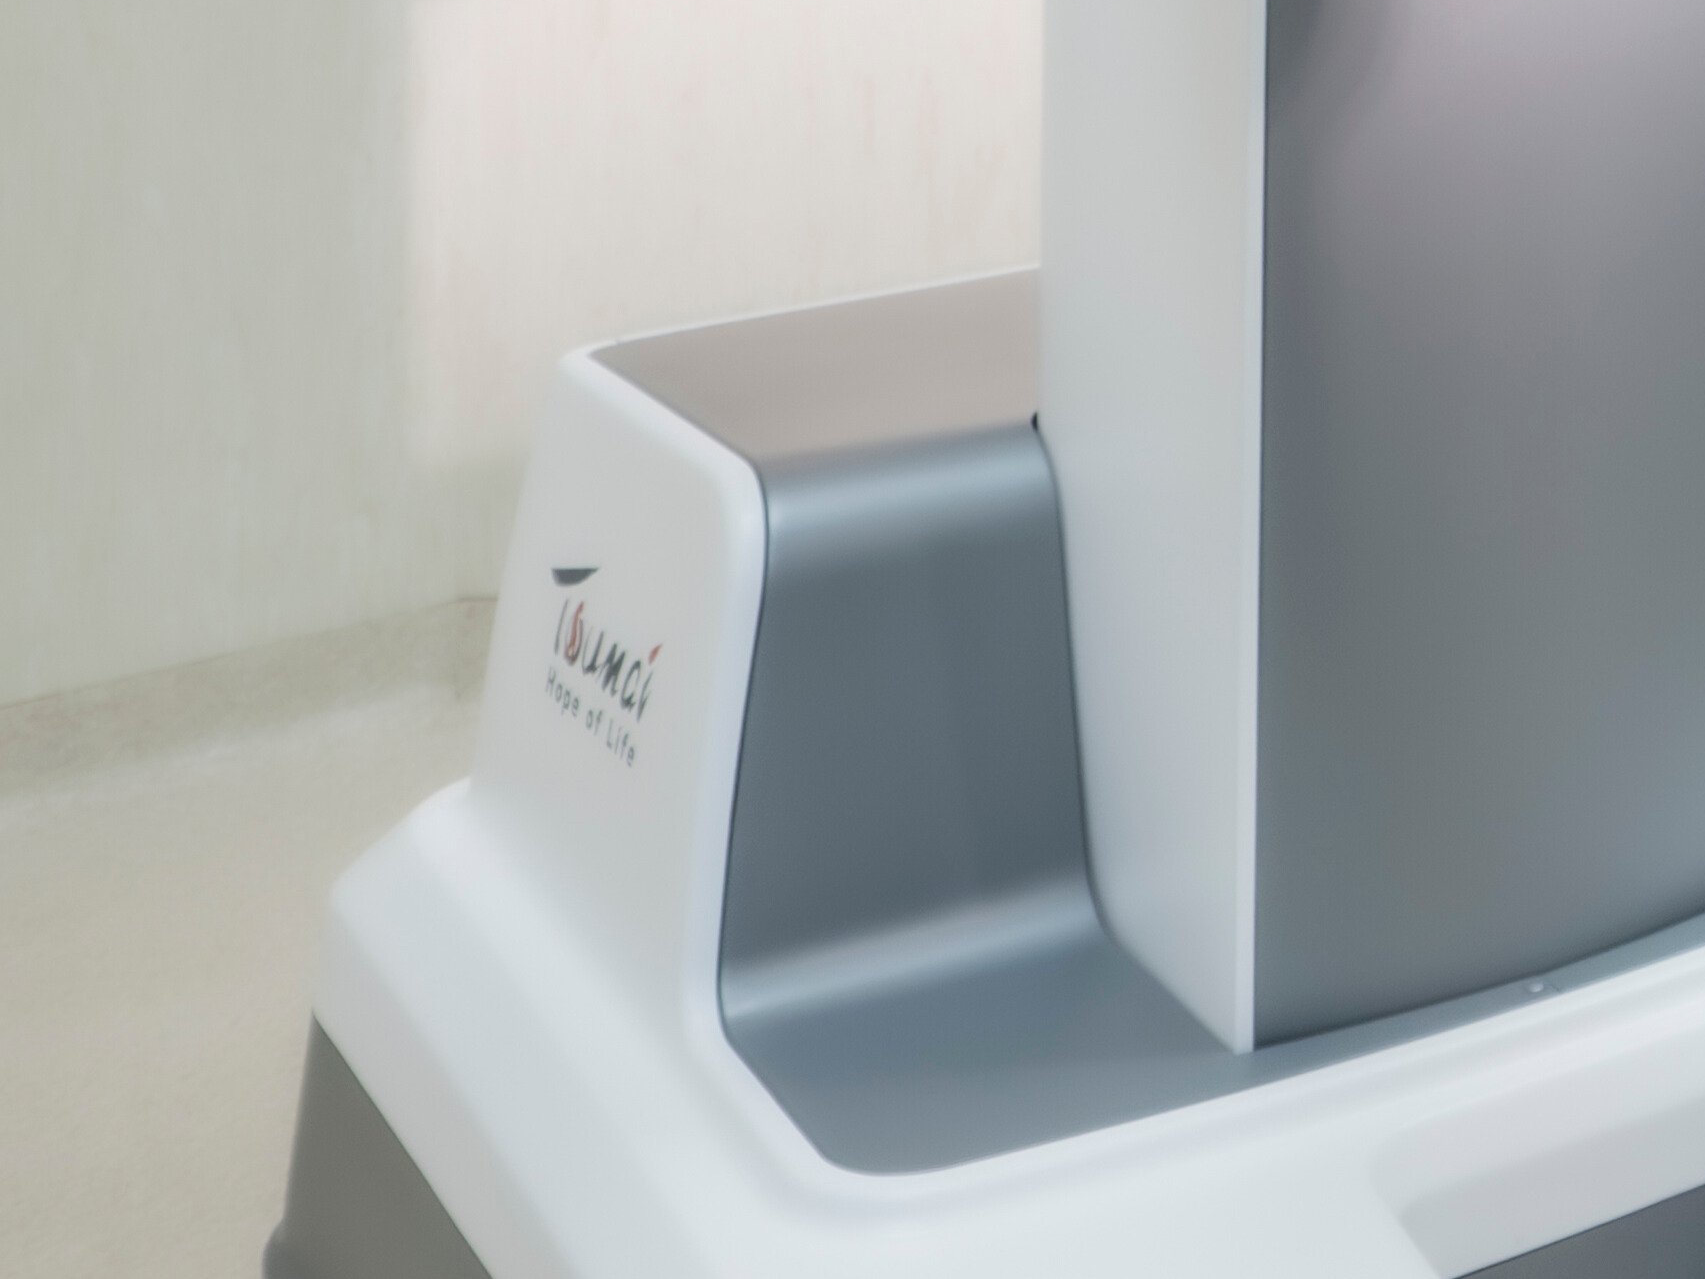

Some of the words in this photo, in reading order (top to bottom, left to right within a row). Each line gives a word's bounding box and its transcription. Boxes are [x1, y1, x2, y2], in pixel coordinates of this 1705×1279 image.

[545, 666, 581, 717] Hope
[585, 709, 603, 736] of
[605, 718, 636, 768] Life
